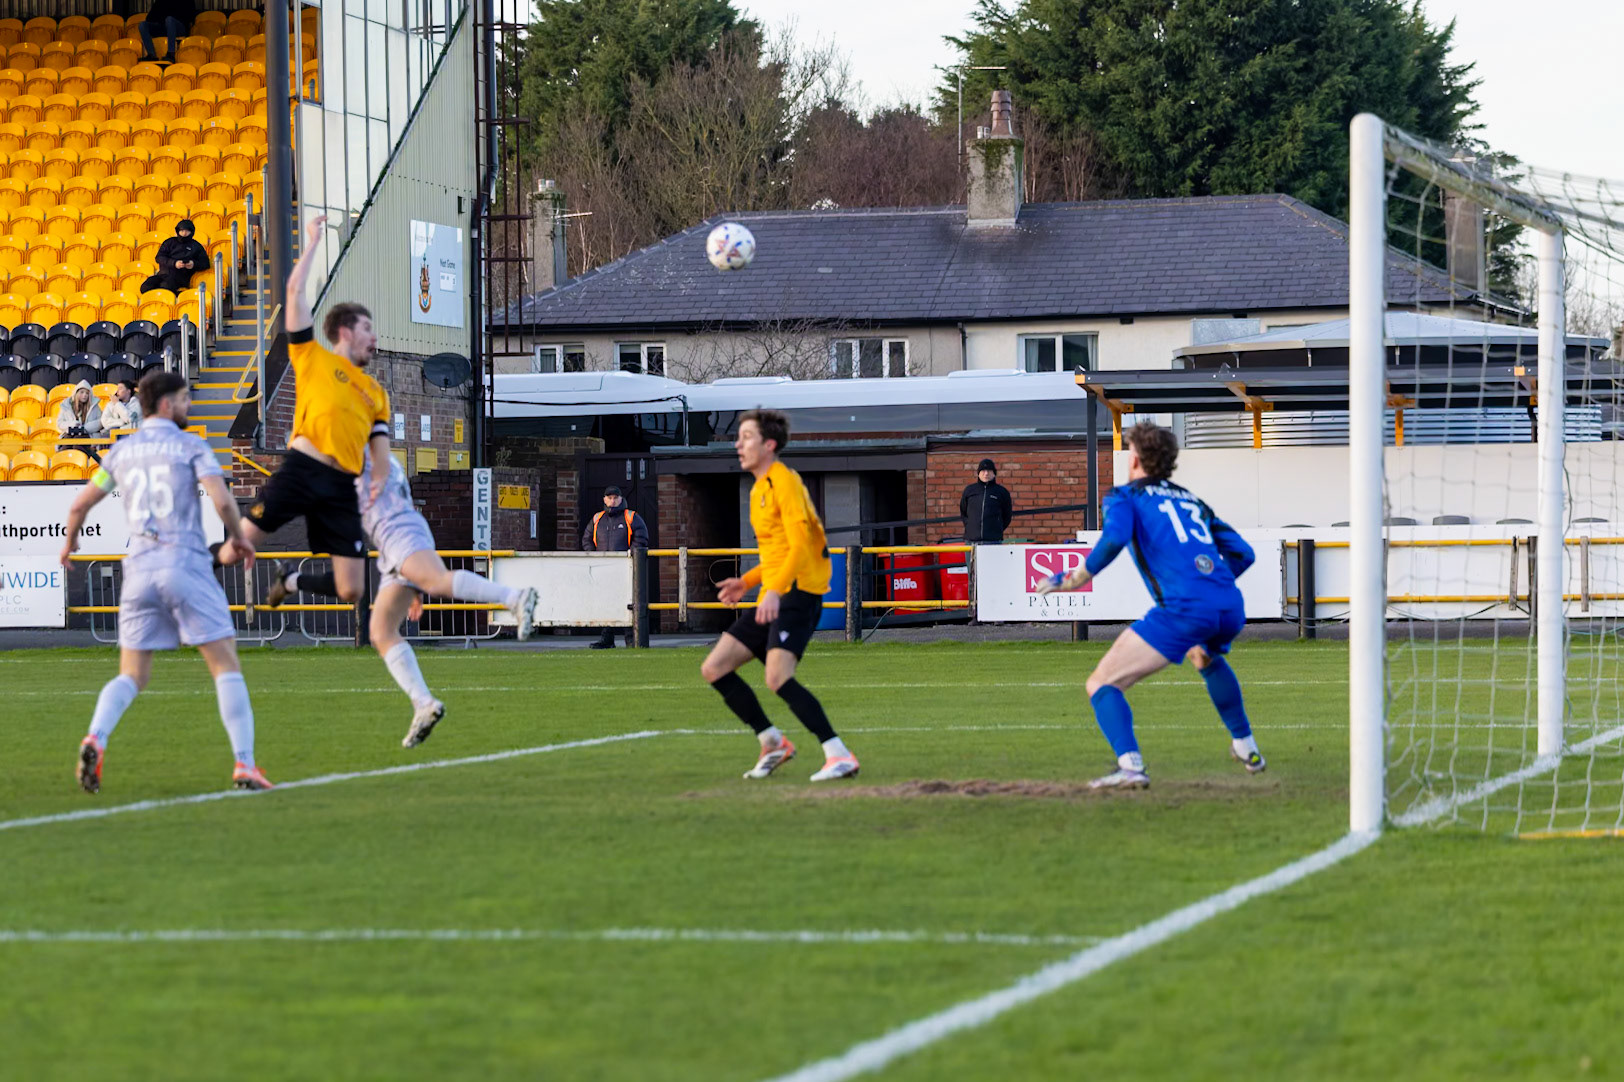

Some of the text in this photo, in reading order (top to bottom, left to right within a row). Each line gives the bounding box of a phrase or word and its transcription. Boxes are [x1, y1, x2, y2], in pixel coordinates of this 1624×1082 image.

[125, 464, 174, 520] 25
[477, 470, 489, 551] GENTS
[1158, 499, 1213, 544] 13
[0, 523, 102, 540] thportfcnet
[893, 578, 918, 590] Biffa
[1029, 595, 1091, 607] PATEL
[1040, 608, 1079, 617] & Co.
